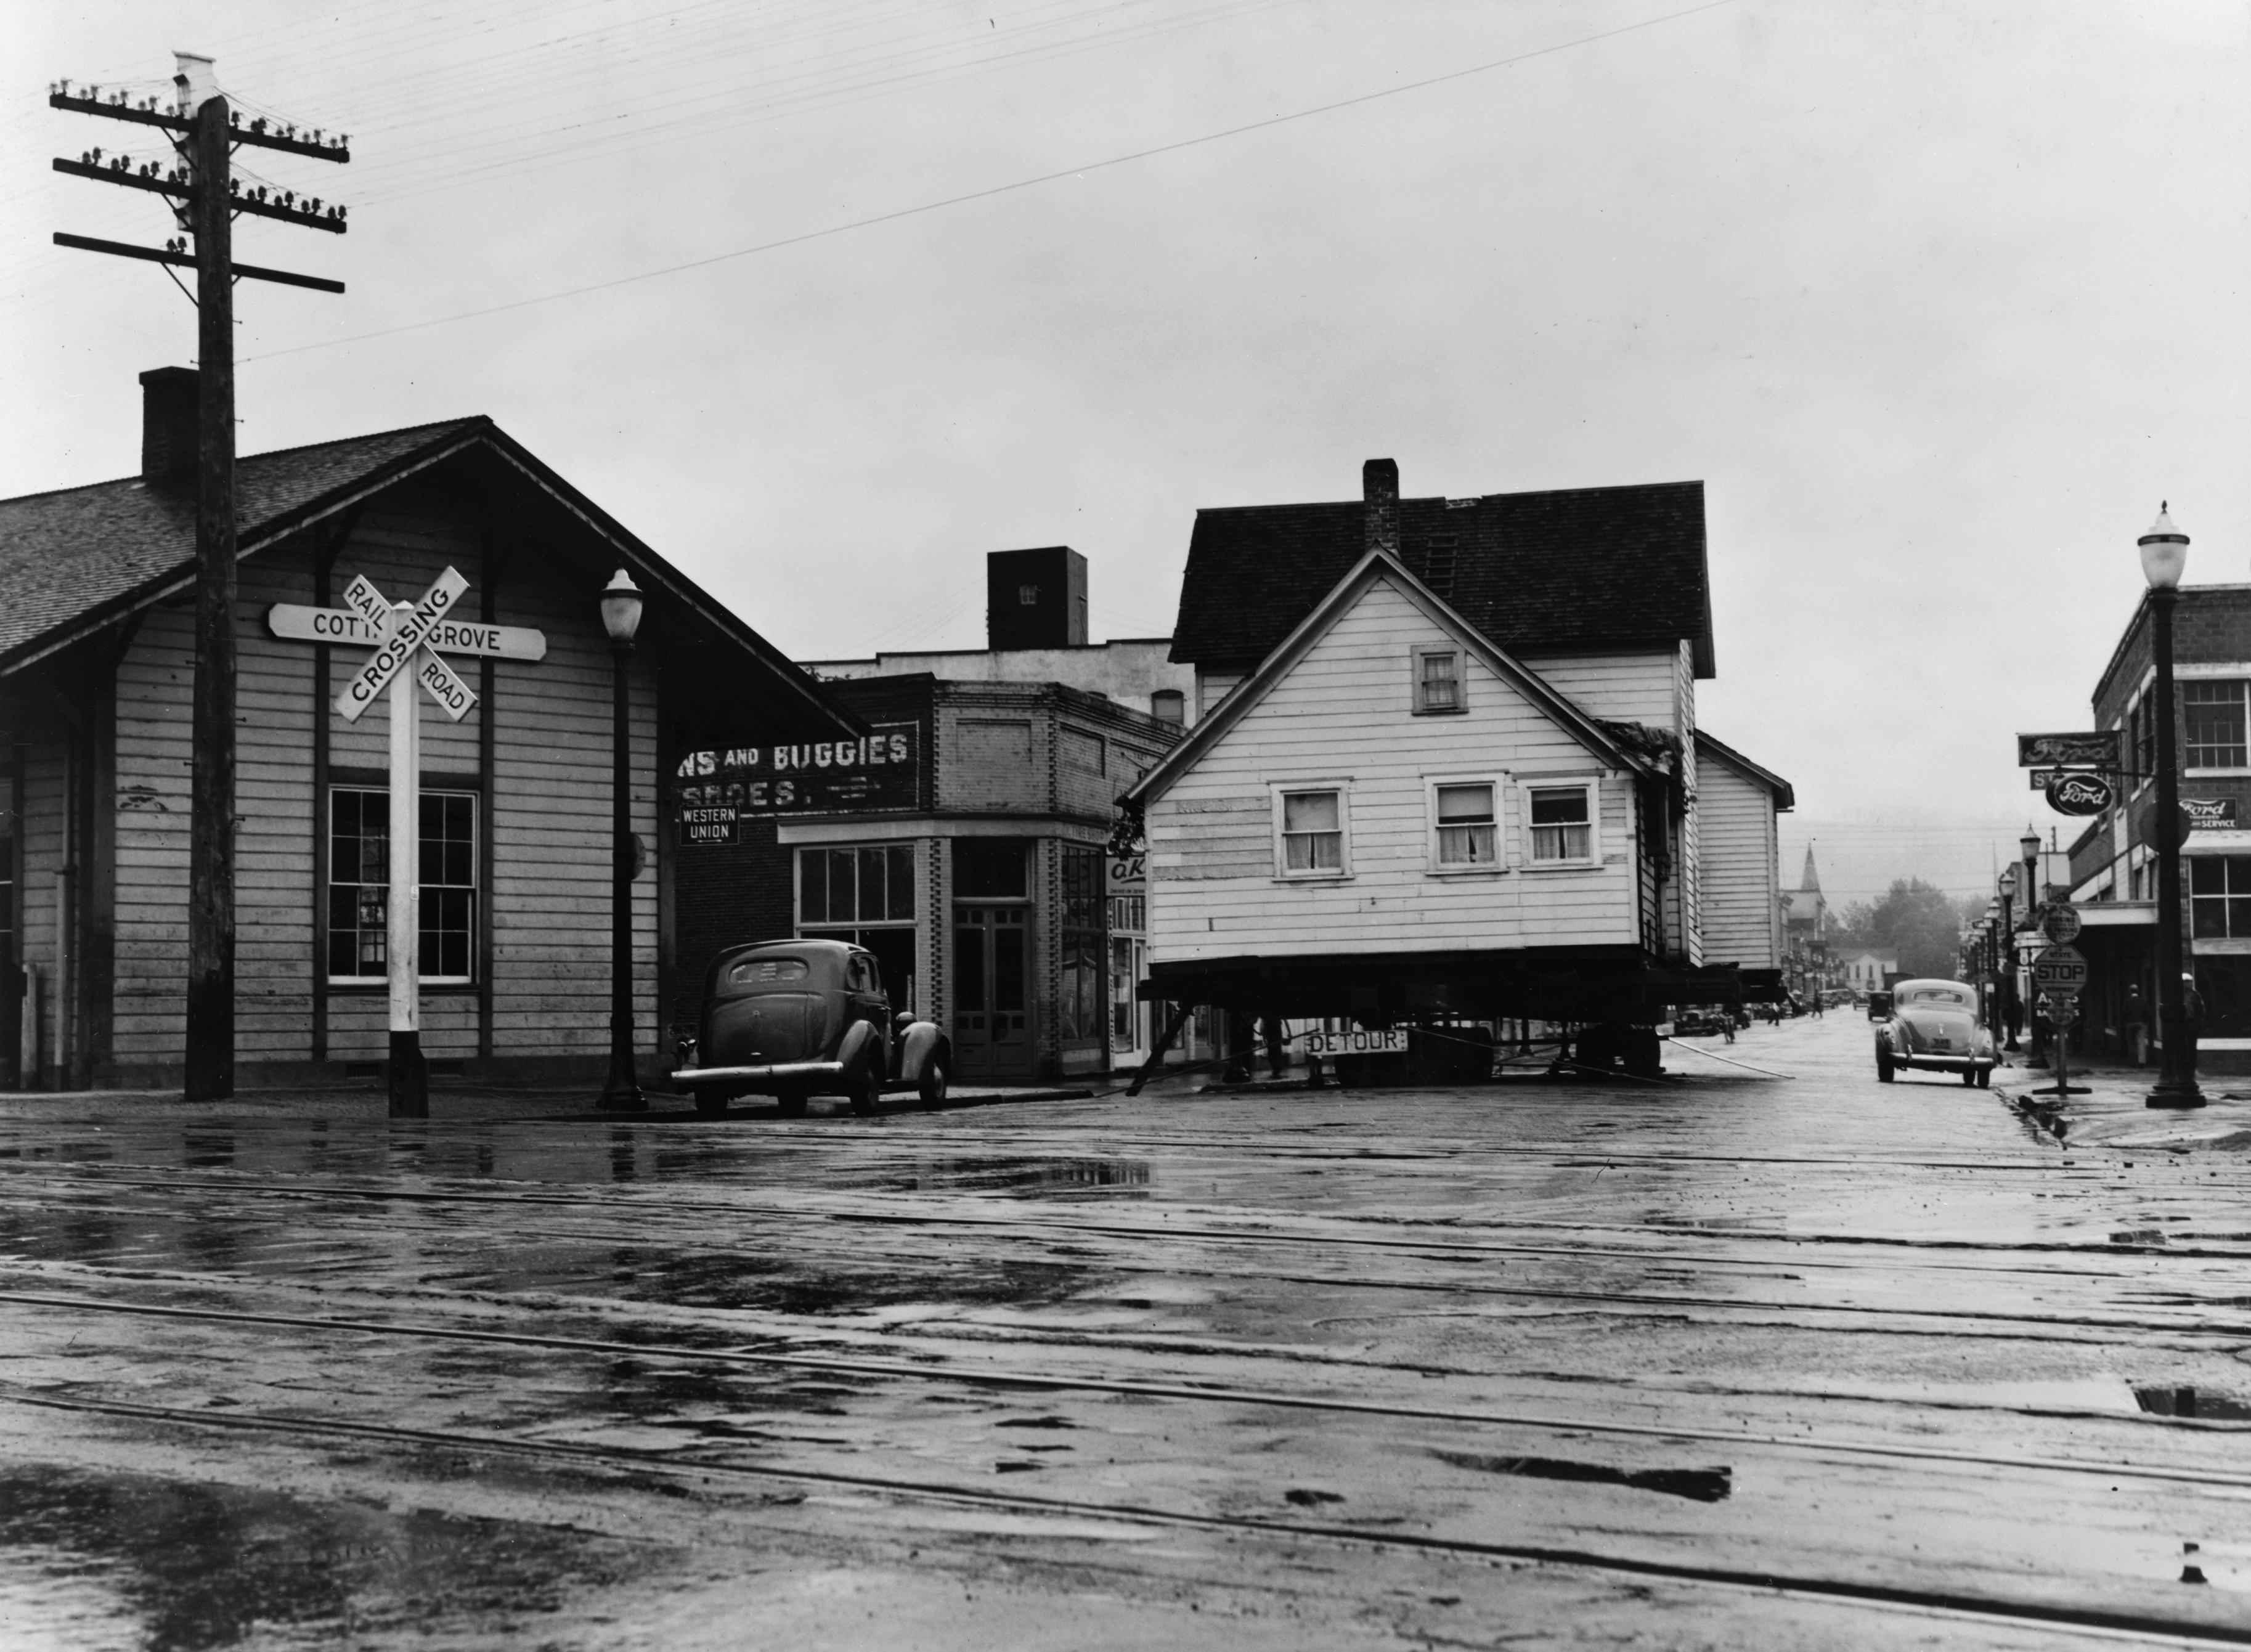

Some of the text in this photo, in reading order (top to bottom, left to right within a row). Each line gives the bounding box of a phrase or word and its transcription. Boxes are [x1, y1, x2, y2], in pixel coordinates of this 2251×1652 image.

[348, 582, 465, 710] RAIL ROAD
[351, 588, 449, 702] CROSSING
[428, 625, 500, 651] GROVE
[723, 747, 759, 767] AND
[774, 734, 908, 770] BUGGIES
[2059, 780, 2106, 805] Ford
[683, 808, 736, 823] WESTERN
[2201, 819, 2236, 828] SERVICE
[690, 824, 730, 839] UNION
[2037, 964, 2085, 980] STOP
[1309, 1031, 1398, 1052] DETOUR
